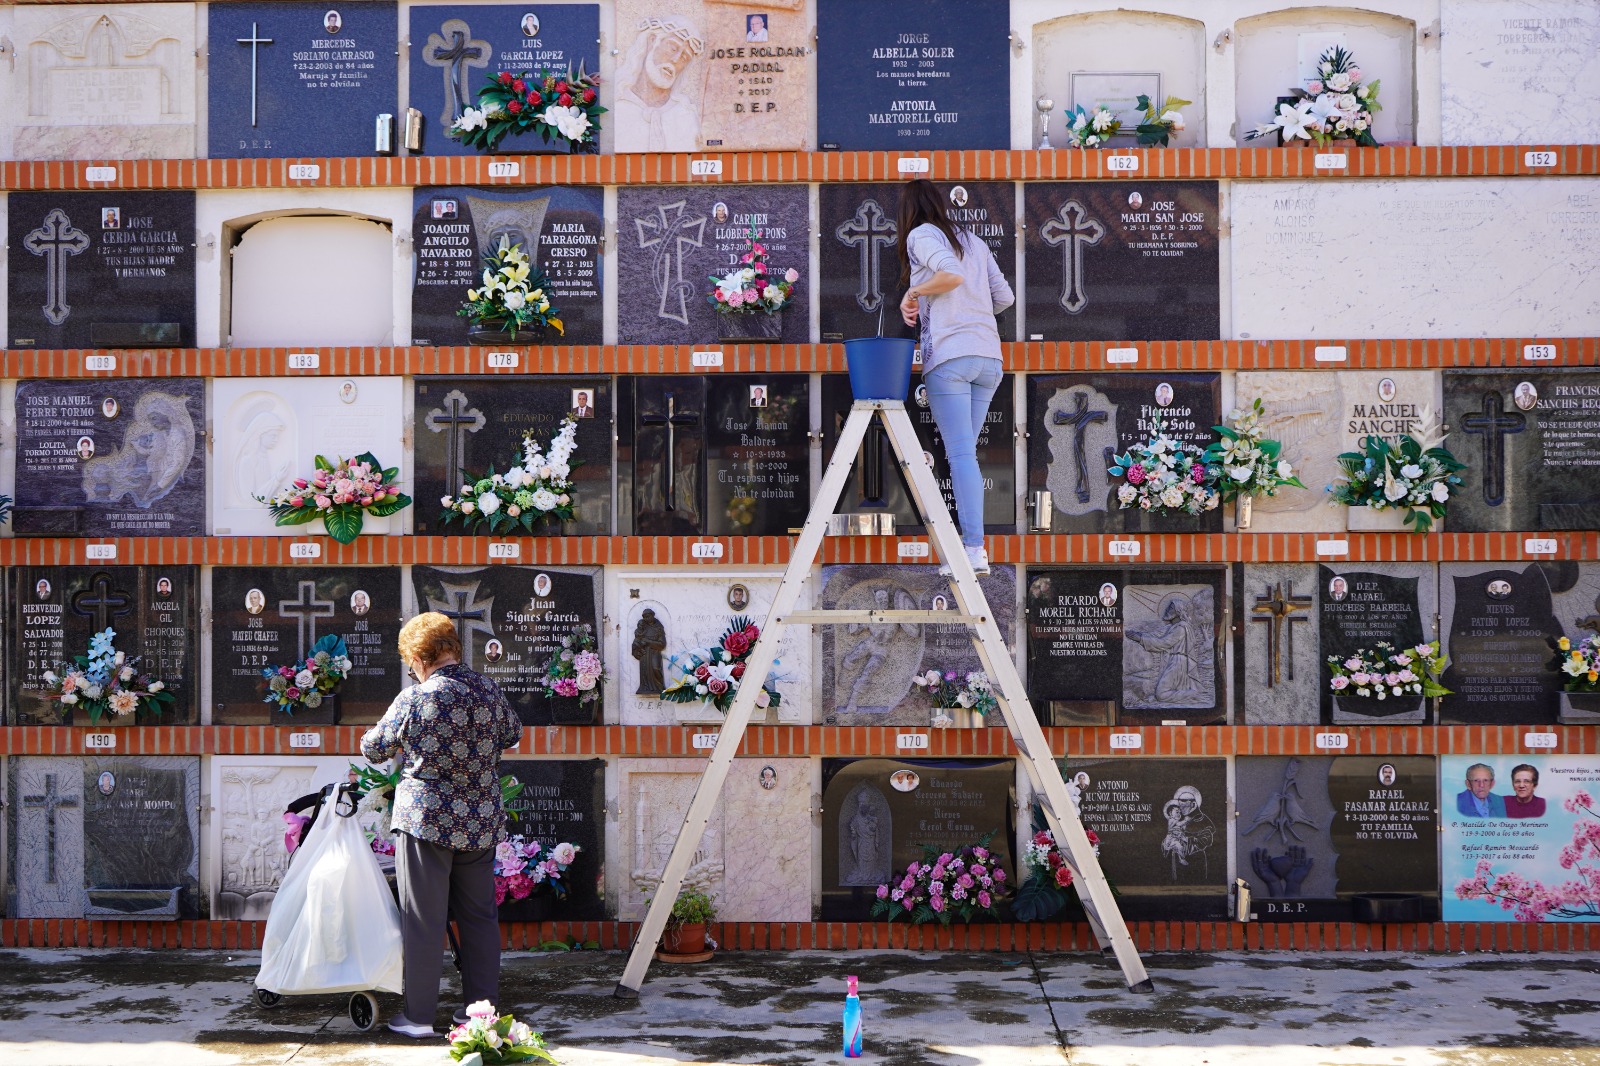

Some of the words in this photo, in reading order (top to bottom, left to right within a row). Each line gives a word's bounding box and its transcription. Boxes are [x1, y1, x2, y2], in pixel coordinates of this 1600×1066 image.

[897, 33, 929, 44] JORGE
[312, 40, 355, 48] MERCEDES
[522, 40, 542, 48] LUIS
[293, 52, 329, 61] SORIANO
[331, 51, 374, 60] CARRASCO
[501, 52, 533, 60] GARCIA
[536, 51, 563, 60] LOPEZ
[710, 49, 745, 59] JOSE
[749, 47, 805, 58] ROLDAN
[872, 48, 919, 58] ALBELLA
[922, 48, 954, 58] SOLER
[731, 63, 784, 74] PADIAL
[891, 101, 936, 111] ANTONIA
[869, 113, 931, 124] MARTORELL
[934, 113, 958, 123] GUIU
[1113, 157, 1132, 168] 162
[1531, 154, 1550, 165] 152
[295, 167, 313, 177] 182
[495, 164, 512, 175] 177
[698, 162, 716, 173] 172
[1150, 202, 1175, 211] JOSE
[1273, 199, 1316, 212] AMPARO
[127, 217, 153, 229] JOSE
[1121, 213, 1150, 223] MARTI
[1155, 213, 1174, 222] SAN
[1180, 213, 1204, 222] JOSE
[422, 224, 470, 234] JOAQUIN
[552, 224, 585, 233] MARIA
[103, 231, 136, 244] CERDA
[140, 231, 177, 243] GARCIA
[765, 229, 786, 239] PONS
[424, 237, 469, 246] ANGULO
[540, 235, 597, 245] TARRAGONA
[421, 249, 472, 258] NAVARRO
[551, 248, 587, 257] CRESPO
[417, 278, 448, 286] Descanse
[1530, 346, 1549, 359] 153
[295, 356, 313, 366] 183
[494, 354, 512, 365] 178
[26, 396, 50, 406] JOSE
[52, 395, 93, 405] MANUEL
[1537, 400, 1578, 409] SANCHIS
[25, 408, 57, 417] FERRE
[61, 407, 94, 417] TORMO
[1353, 404, 1419, 418] MANUEL
[503, 413, 553, 422] EDUARDO
[1170, 420, 1196, 430] Soto
[737, 472, 766, 483] esposa
[778, 470, 799, 483] hijos
[734, 485, 747, 498] No
[296, 545, 314, 555] 184
[495, 545, 513, 556] 179
[699, 545, 715, 556] 174
[1115, 543, 1133, 553] 164
[1531, 541, 1550, 552] 154
[1058, 596, 1098, 606] RICARDO
[1351, 593, 1385, 601] RAFAEL
[151, 602, 179, 611] ANGELA
[529, 598, 556, 611] Juan
[1039, 608, 1074, 618] MORELL
[1078, 607, 1117, 617] RICHART
[26, 616, 61, 625] LOPEZ
[159, 614, 172, 622] GIL
[248, 618, 263, 628] JOSE
[1506, 617, 1530, 626] LOPEZ
[505, 652, 521, 662] Julia
[91, 735, 109, 746] 190
[295, 735, 313, 746] 185
[699, 735, 717, 747] 175
[903, 736, 921, 747] 170
[1116, 736, 1134, 746] 165
[1323, 735, 1341, 746] 160
[1097, 781, 1128, 790] ANTONIO
[522, 785, 560, 797] ANTONIO
[1369, 789, 1404, 799] RAFAEL
[1113, 792, 1139, 801] TORRES
[537, 800, 575, 811] PERALES
[1345, 802, 1386, 812] FASANAR
[1389, 801, 1429, 811] ALCARAZ
[1375, 823, 1413, 831] FAMILIA
[1462, 844, 1483, 852] Rafael
